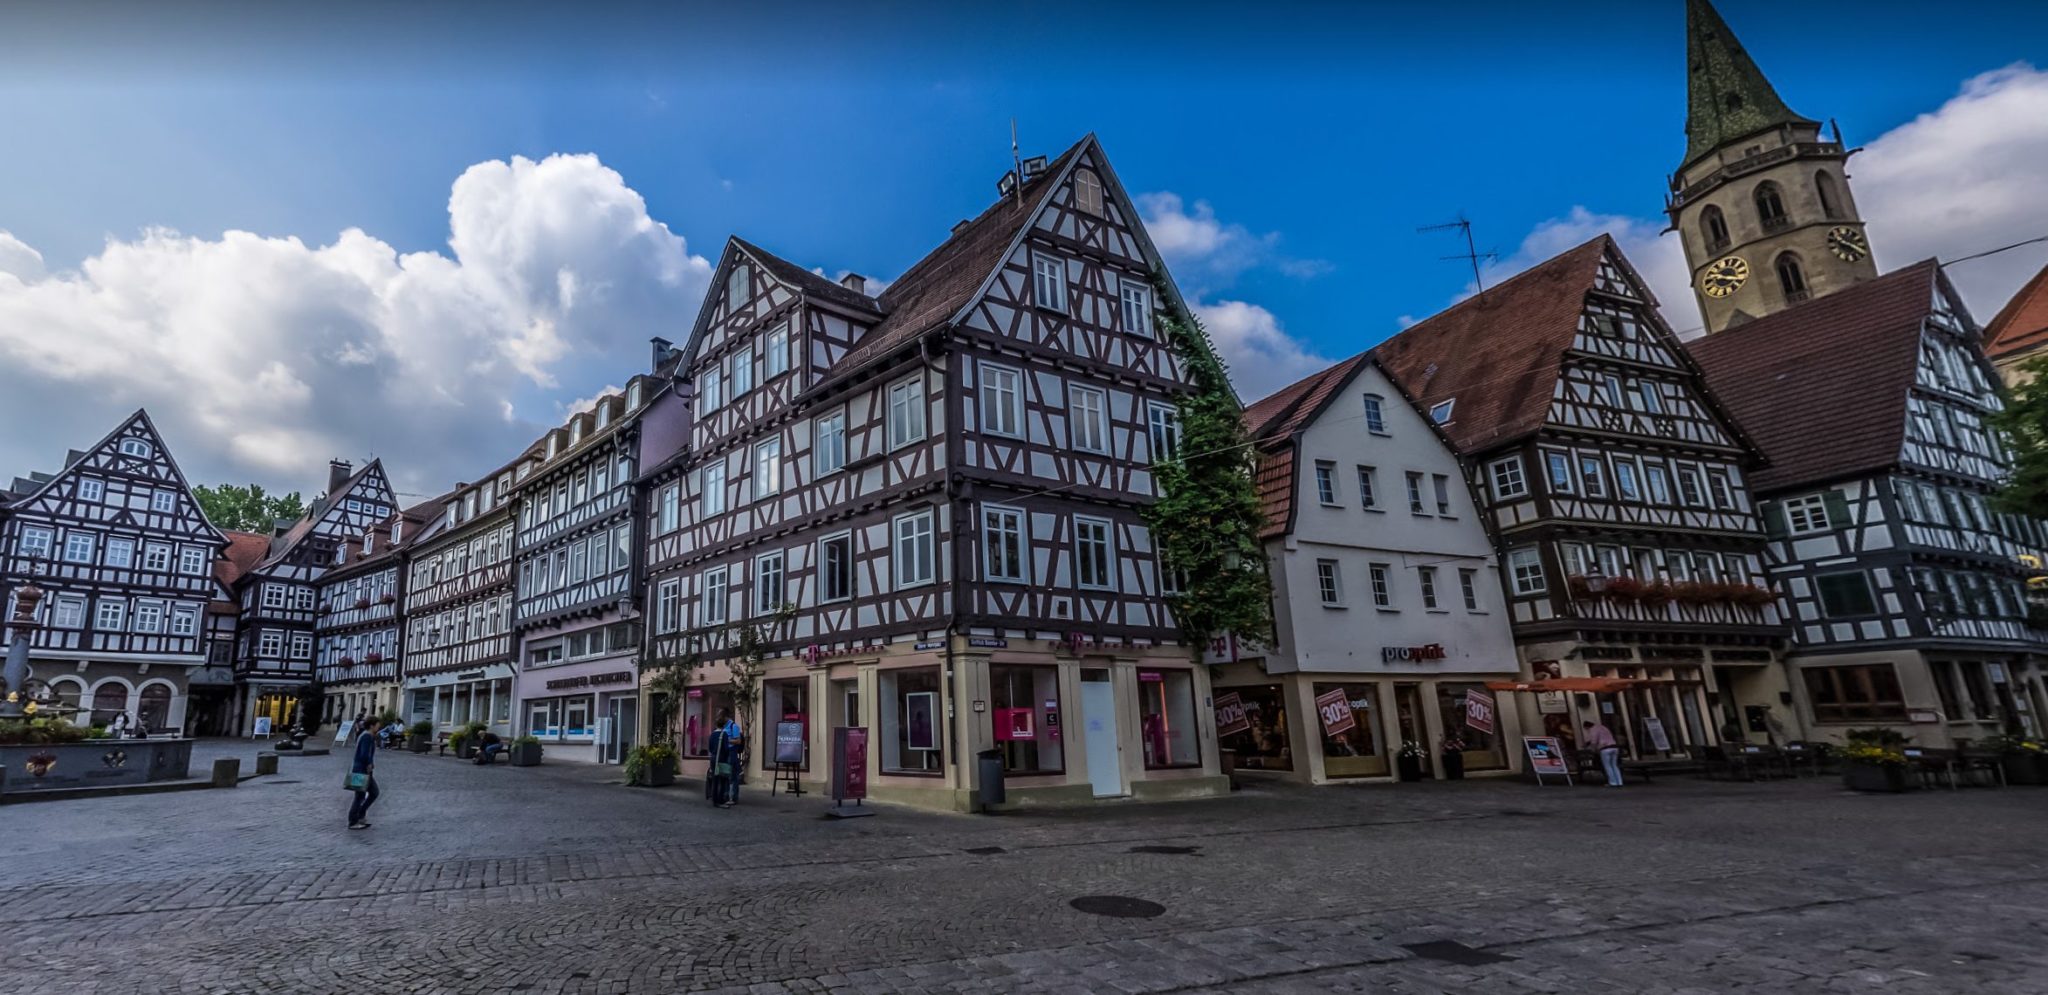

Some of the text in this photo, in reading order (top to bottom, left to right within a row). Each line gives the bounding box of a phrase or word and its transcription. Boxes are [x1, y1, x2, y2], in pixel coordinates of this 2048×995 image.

[808, 644, 819, 665] T
[1216, 703, 1243, 726] 30%
[1322, 700, 1348, 725] 30%
[1469, 700, 1492, 720] 30%
